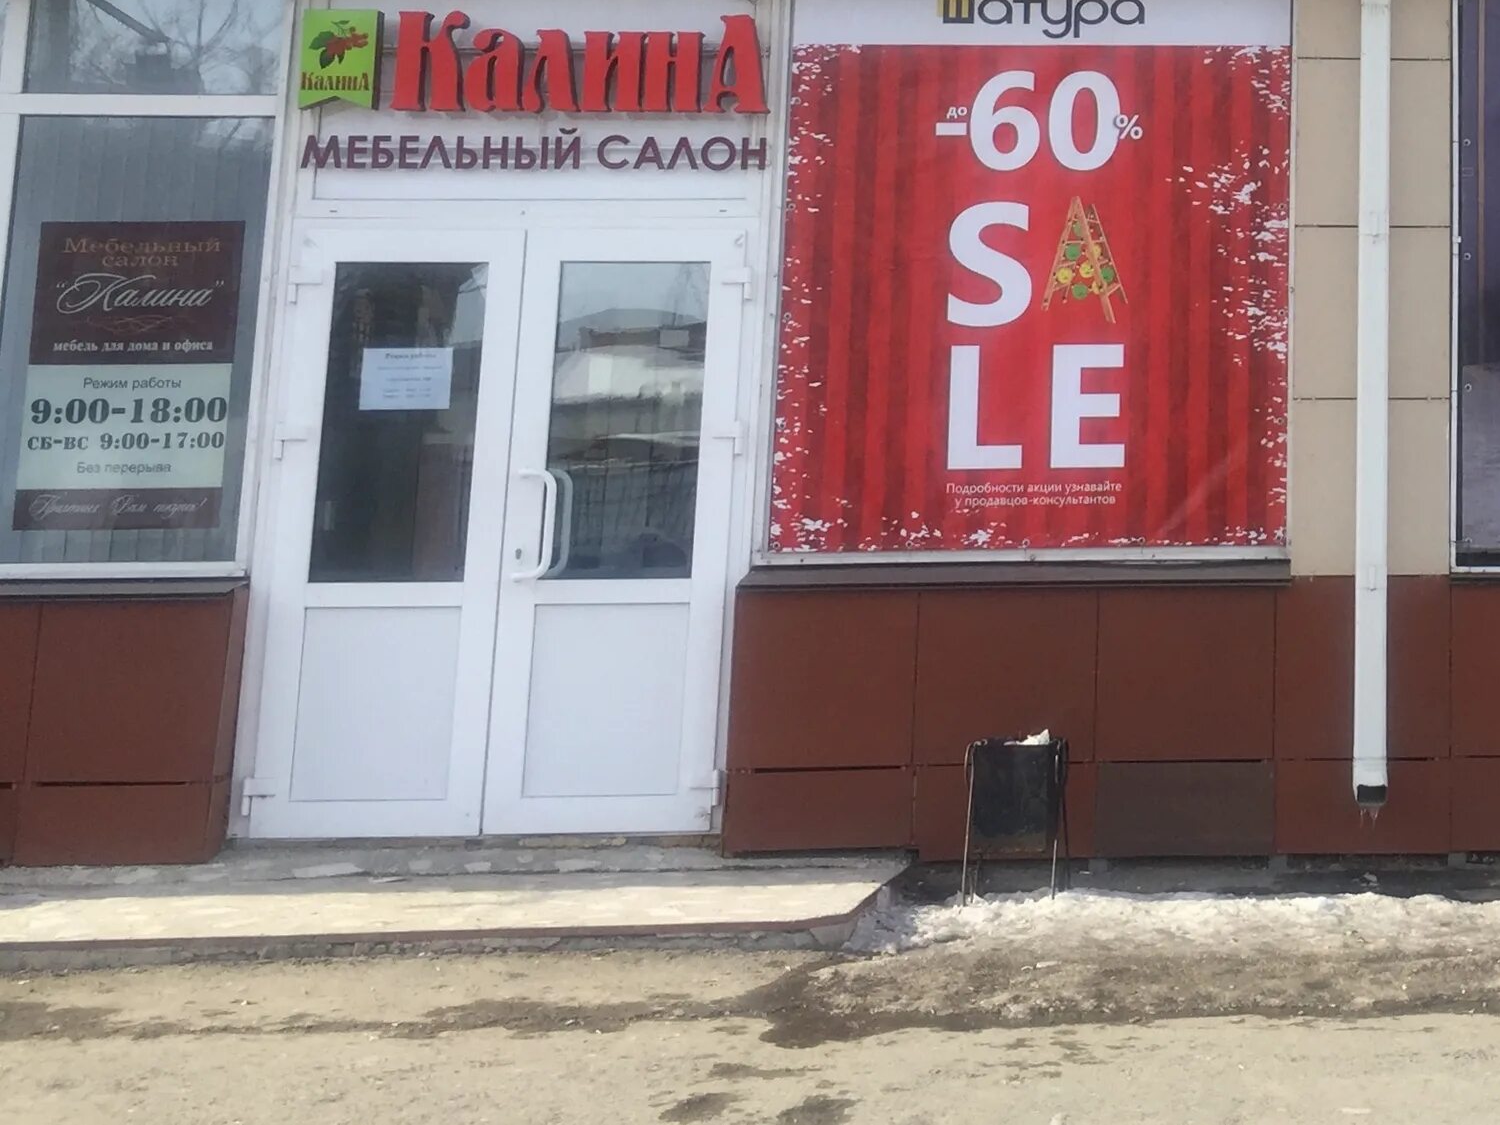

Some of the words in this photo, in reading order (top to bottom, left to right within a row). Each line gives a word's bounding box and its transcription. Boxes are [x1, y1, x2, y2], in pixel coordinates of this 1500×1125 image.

[946, 105, 968, 119] до
[300, 127, 582, 170] МЕБЕЛЬНЫЙ
[597, 134, 768, 171] САЛОН
[63, 236, 222, 254] Мебельный
[102, 254, 179, 268] салон
[53, 339, 98, 352] мебель
[101, 341, 125, 353] для
[127, 342, 159, 353] дома
[162, 341, 171, 352] и
[174, 339, 213, 353] офиса
[83, 377, 128, 389] Режим
[132, 377, 182, 391] работы
[30, 396, 228, 425] 9:00-18:00
[100, 431, 225, 451] 9:00-17:00
[76, 461, 100, 473] Без
[104, 462, 172, 476] перерыва
[946, 482, 1024, 496] Подробности
[1026, 483, 1062, 495] акции
[1064, 481, 1122, 495] узнавайте
[954, 498, 962, 508] у
[964, 494, 1117, 508] продавцов-консультантов
